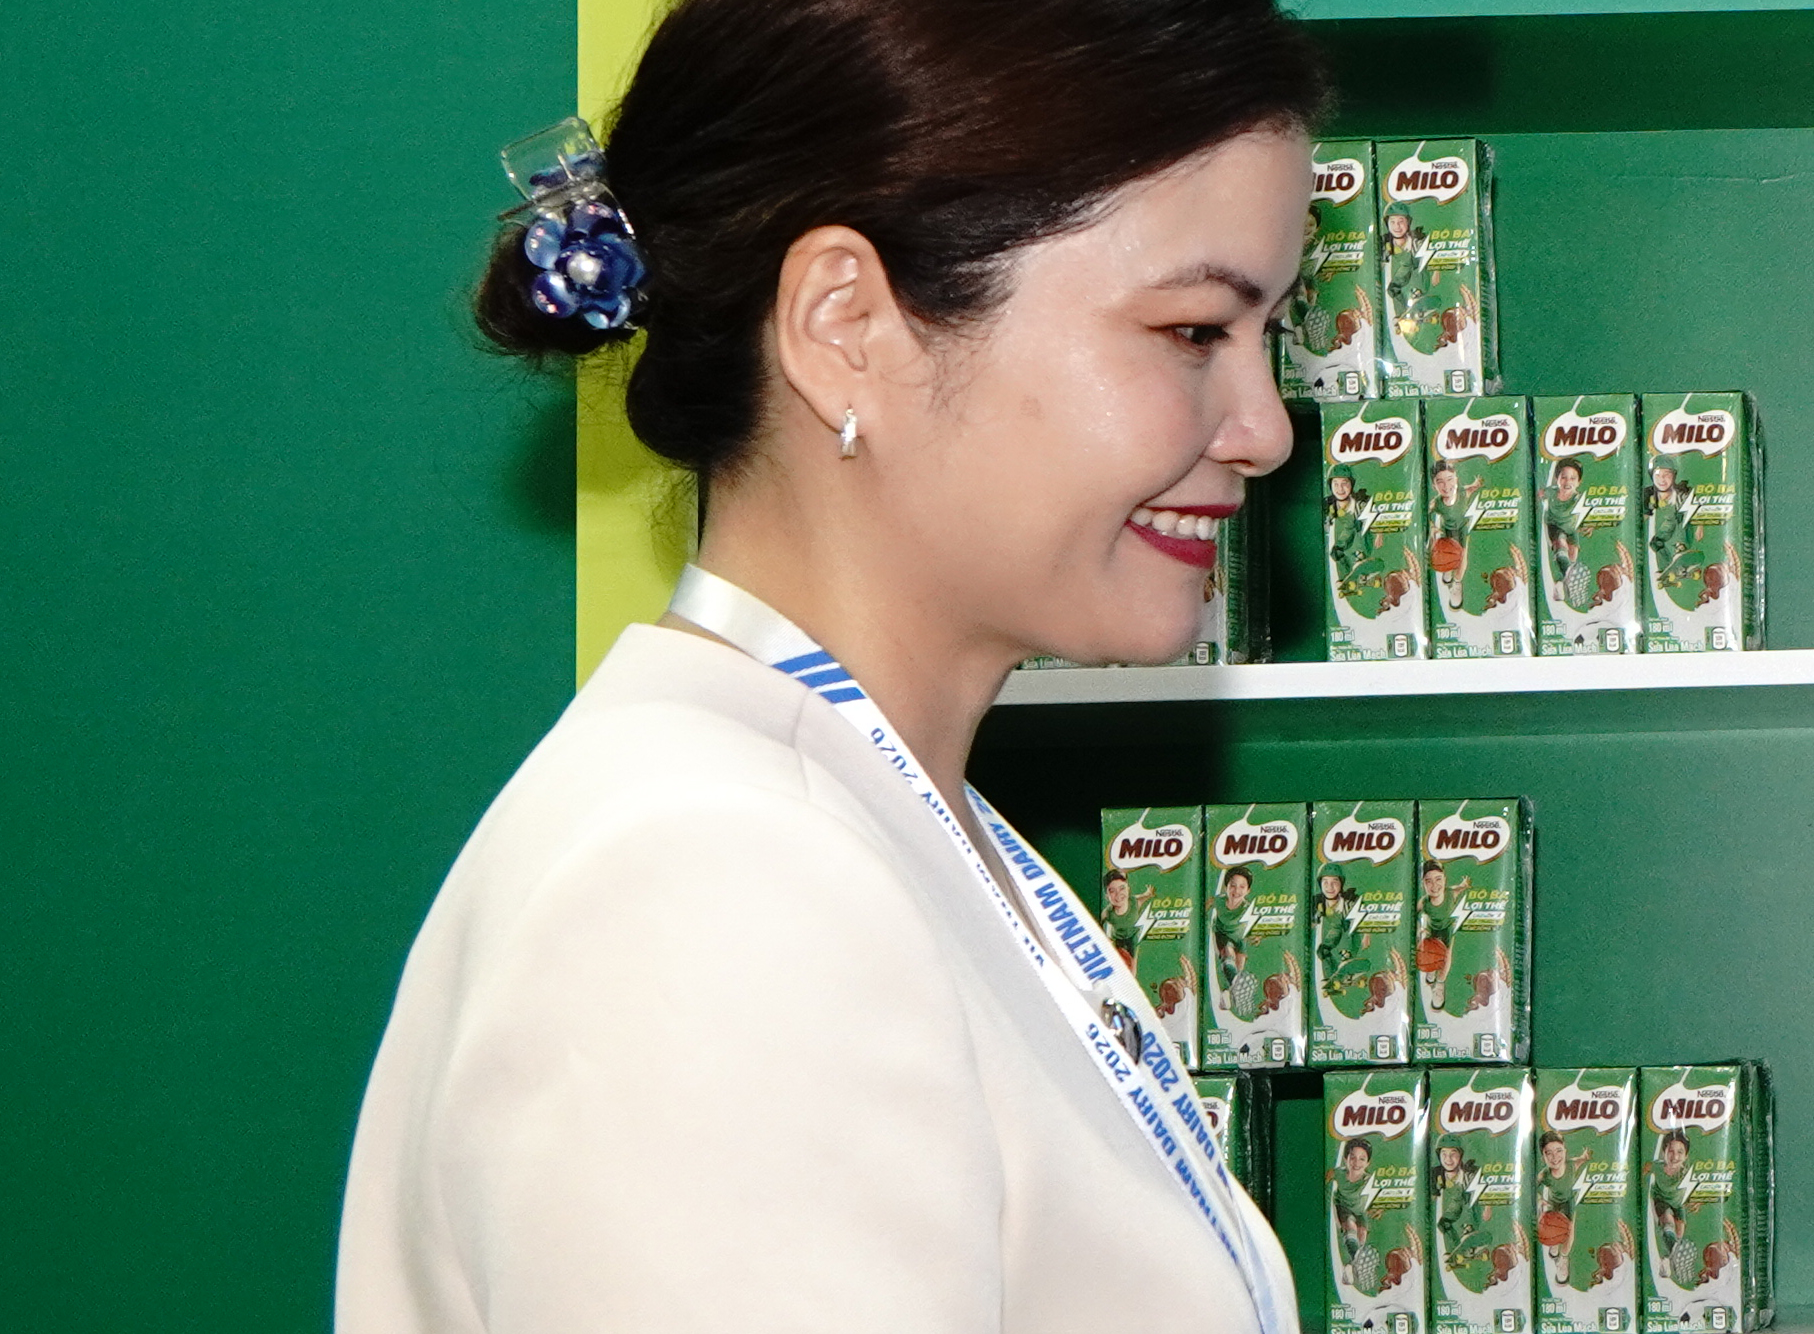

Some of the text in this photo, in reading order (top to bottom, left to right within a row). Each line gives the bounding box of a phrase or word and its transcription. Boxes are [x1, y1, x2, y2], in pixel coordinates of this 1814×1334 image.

[1396, 170, 1459, 192] MILO
[1339, 432, 1403, 453] MILO
[1661, 424, 1725, 445] MILO
[1118, 836, 1183, 859] MILO
[1436, 829, 1500, 851] MILO
[989, 820, 1114, 983] VIETNAM DAIRY
[1342, 1105, 1406, 1127] MILO
[1661, 1097, 1725, 1119] MILO
